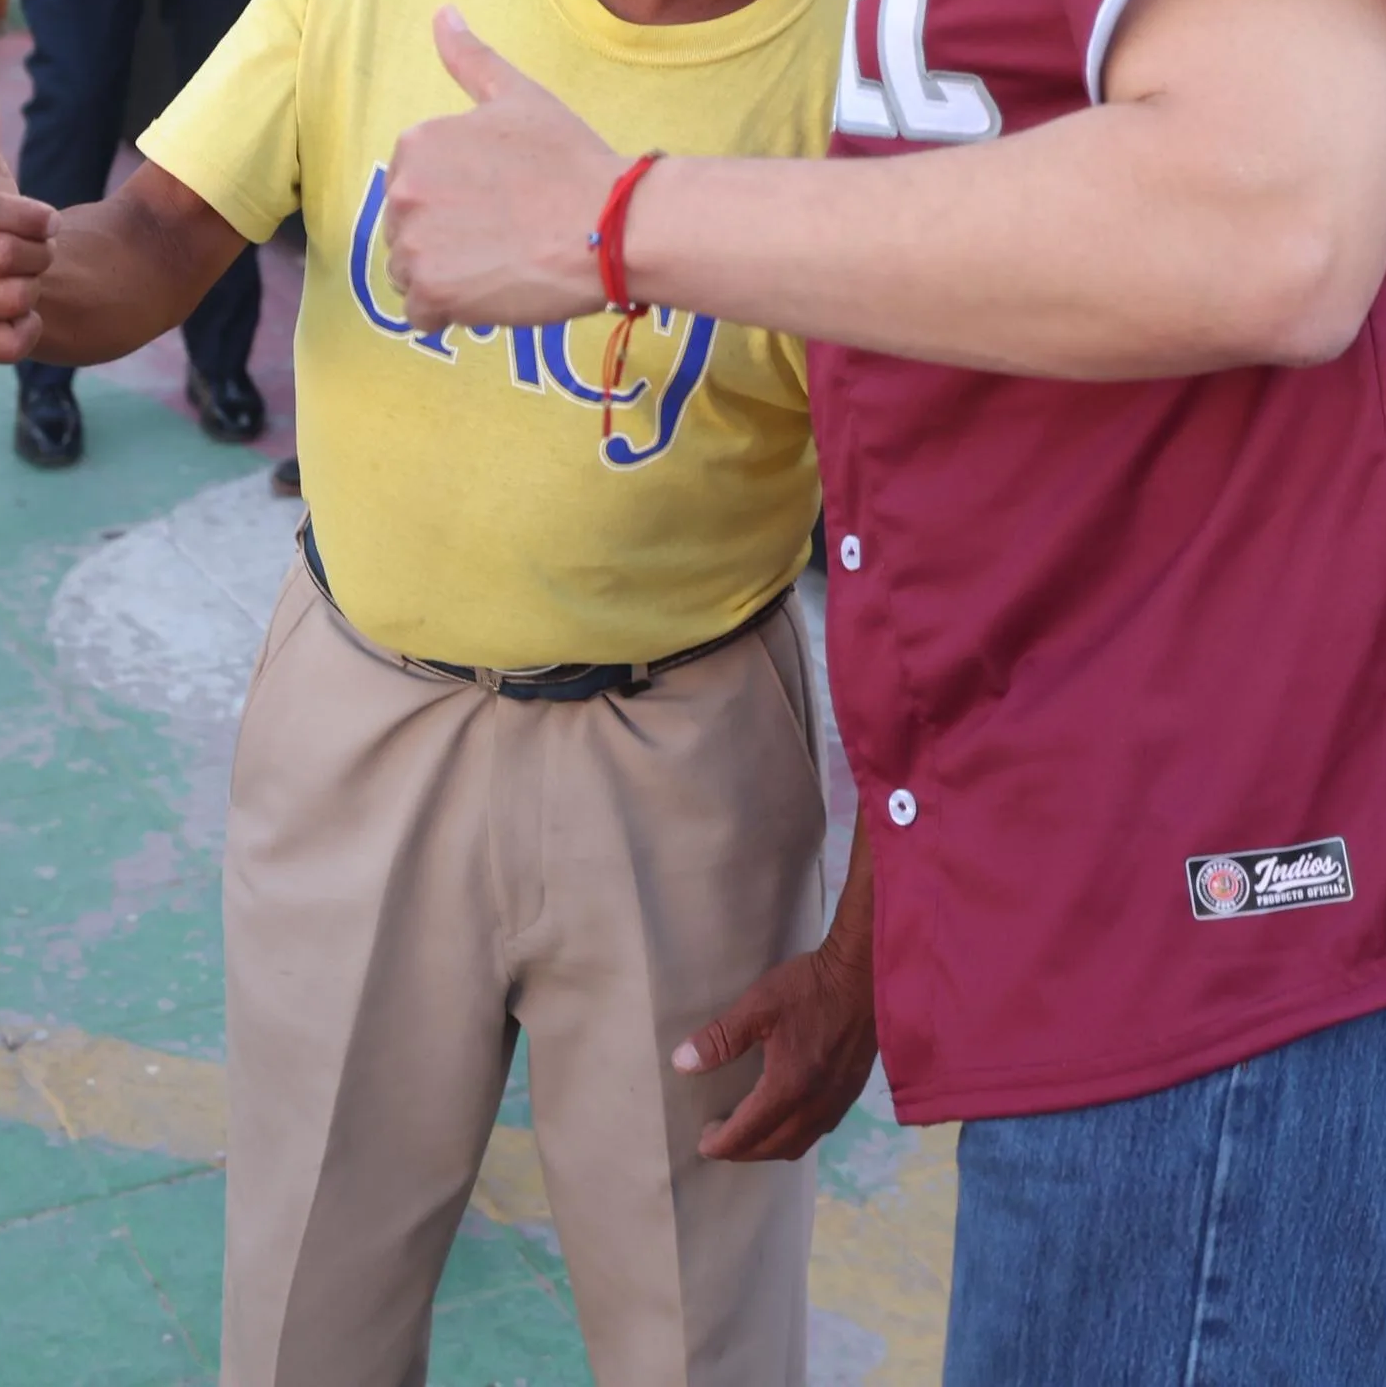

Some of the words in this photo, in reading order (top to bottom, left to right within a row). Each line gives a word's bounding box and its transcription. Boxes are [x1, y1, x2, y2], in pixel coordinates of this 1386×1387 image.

[1254, 853, 1341, 893] Indios
[1257, 891, 1304, 907] PRODUCTO
[1307, 883, 1346, 899] OFICIAL
